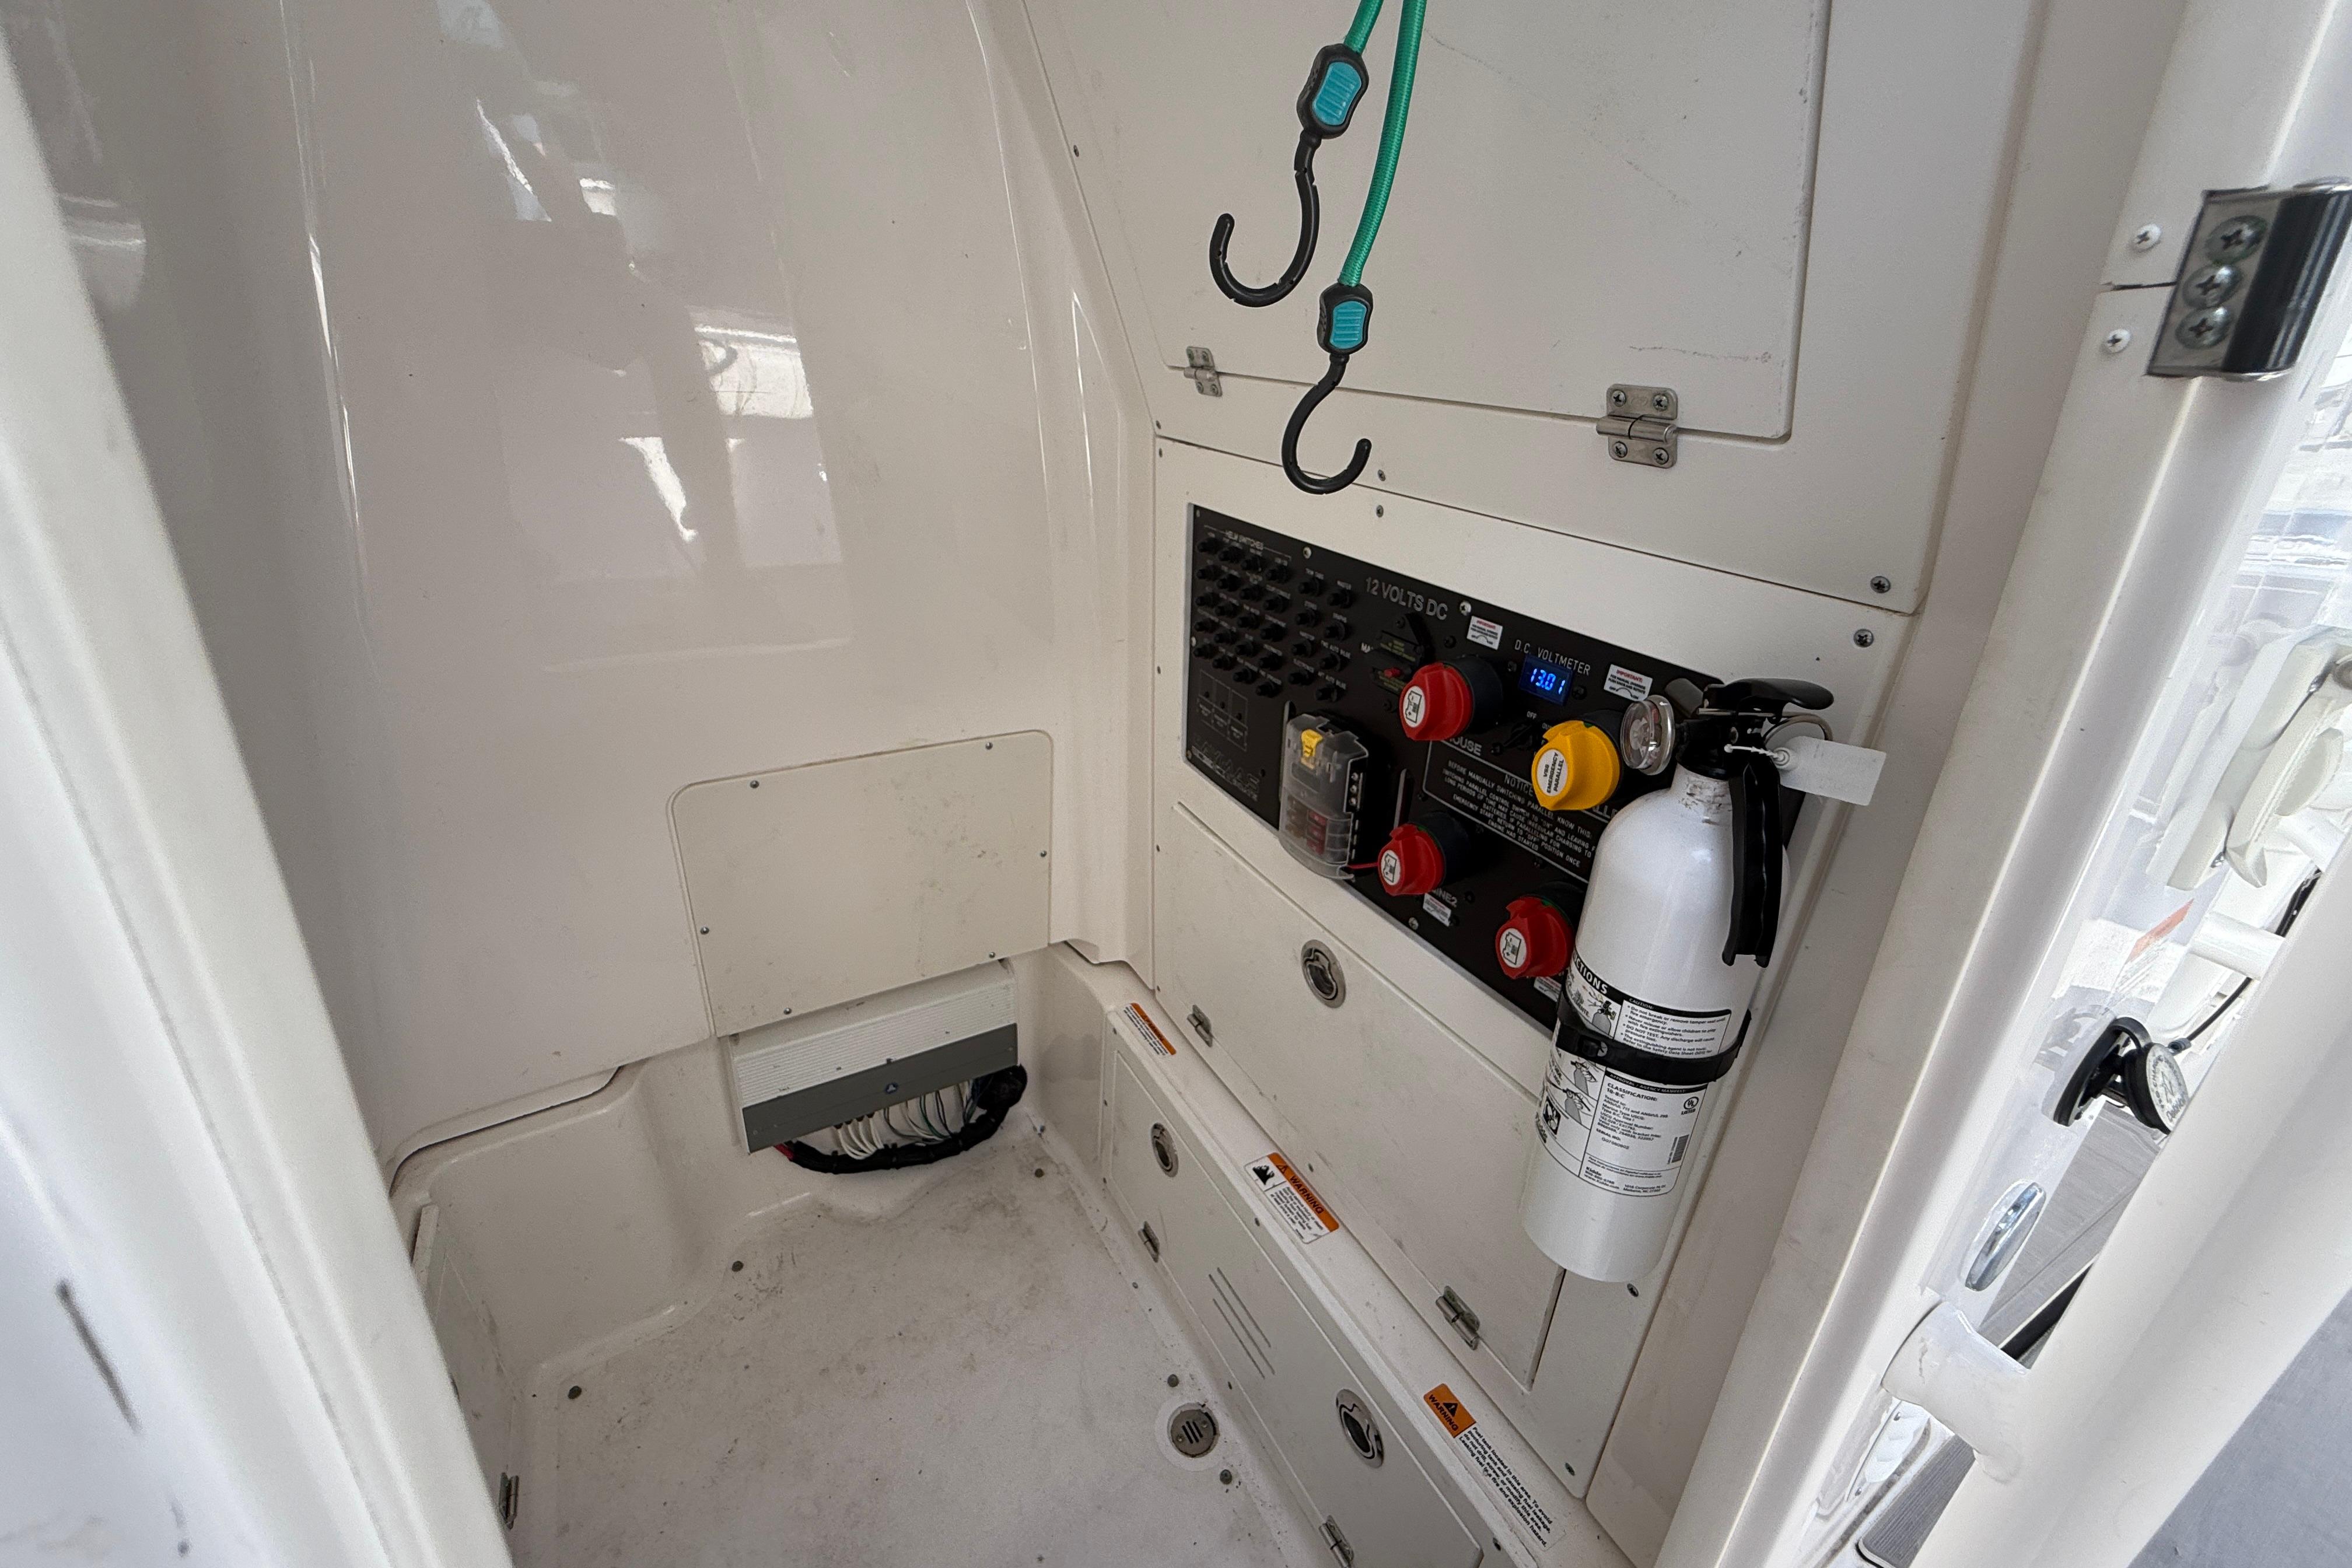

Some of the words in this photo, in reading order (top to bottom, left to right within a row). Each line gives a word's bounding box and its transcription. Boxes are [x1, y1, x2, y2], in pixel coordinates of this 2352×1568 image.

[1366, 577, 1379, 595] 12
[1381, 582, 1424, 611] VOLTS
[1426, 598, 1448, 620] DC
[1514, 639, 1531, 654] D.C.
[1538, 647, 1591, 676] VOLTMETER
[1531, 668, 1566, 695] 13.01
[1527, 711, 1536, 719] OFF
[1450, 736, 1482, 756] OUSE
[1546, 752, 1558, 793] EMERGENCY
[1553, 760, 1564, 792] PARALLEL
[1466, 780, 1487, 796] PARALLEL
[1489, 793, 1510, 807] CONTROL
[1513, 804, 1530, 817] SWITCH
[1555, 827, 1566, 836] AND
[1567, 834, 1589, 849] LEAVING
[1468, 771, 1495, 788] MANUALLY
[1496, 785, 1525, 804] SWITCHING
[1527, 801, 1553, 820] PARALLEL
[1557, 817, 1574, 830] KNOW
[1453, 793, 1479, 811] EMERGENCY
[1497, 817, 1516, 831] RETURN
[1541, 841, 1563, 858] POSITION
[1565, 855, 1581, 868] ONCE
[1486, 797, 1497, 806] TIME
[1498, 804, 1508, 813] MAY
[1510, 810, 1525, 823] CAUSE
[1556, 835, 1582, 853] CHARGING
[1585, 850, 1591, 858] TO
[1488, 819, 1505, 832] ENGINE
[1506, 830, 1516, 839] HAS
[1518, 836, 1539, 851] STARTED
[1629, 998, 1654, 1010] CAUTION:
[1608, 1083, 1657, 1101] CLASSIFICATION:
[1586, 1166, 1602, 1177] Kidde
[1290, 1175, 1324, 1214] WARNING
[1429, 1395, 1458, 1431] WARNING
[1458, 1436, 1476, 1457] Leaking
[1475, 1456, 1485, 1467] fuel
[1491, 1476, 1500, 1487] fire
[1499, 1486, 1509, 1498] and
[1507, 1497, 1531, 1525] explosion
[1530, 1525, 1548, 1546] hazard.
[1469, 1440, 1478, 1450] not
[1505, 1486, 1522, 1506] modify
[1521, 1505, 1531, 1516] this
[1530, 1517, 1542, 1531] area.
[1472, 1426, 1483, 1438] Fuel
[1482, 1437, 1492, 1450] tank
[1490, 1449, 1508, 1469] located
[1511, 1475, 1521, 1486] this
[1520, 1486, 1532, 1500] area.
[1531, 1499, 1540, 1508] To
[1538, 1507, 1552, 1524] avoid
[1487, 1454, 1497, 1466] tank
[1497, 1465, 1506, 1476] and
[1505, 1476, 1524, 1499] causing
[1522, 1498, 1533, 1510] fuel
